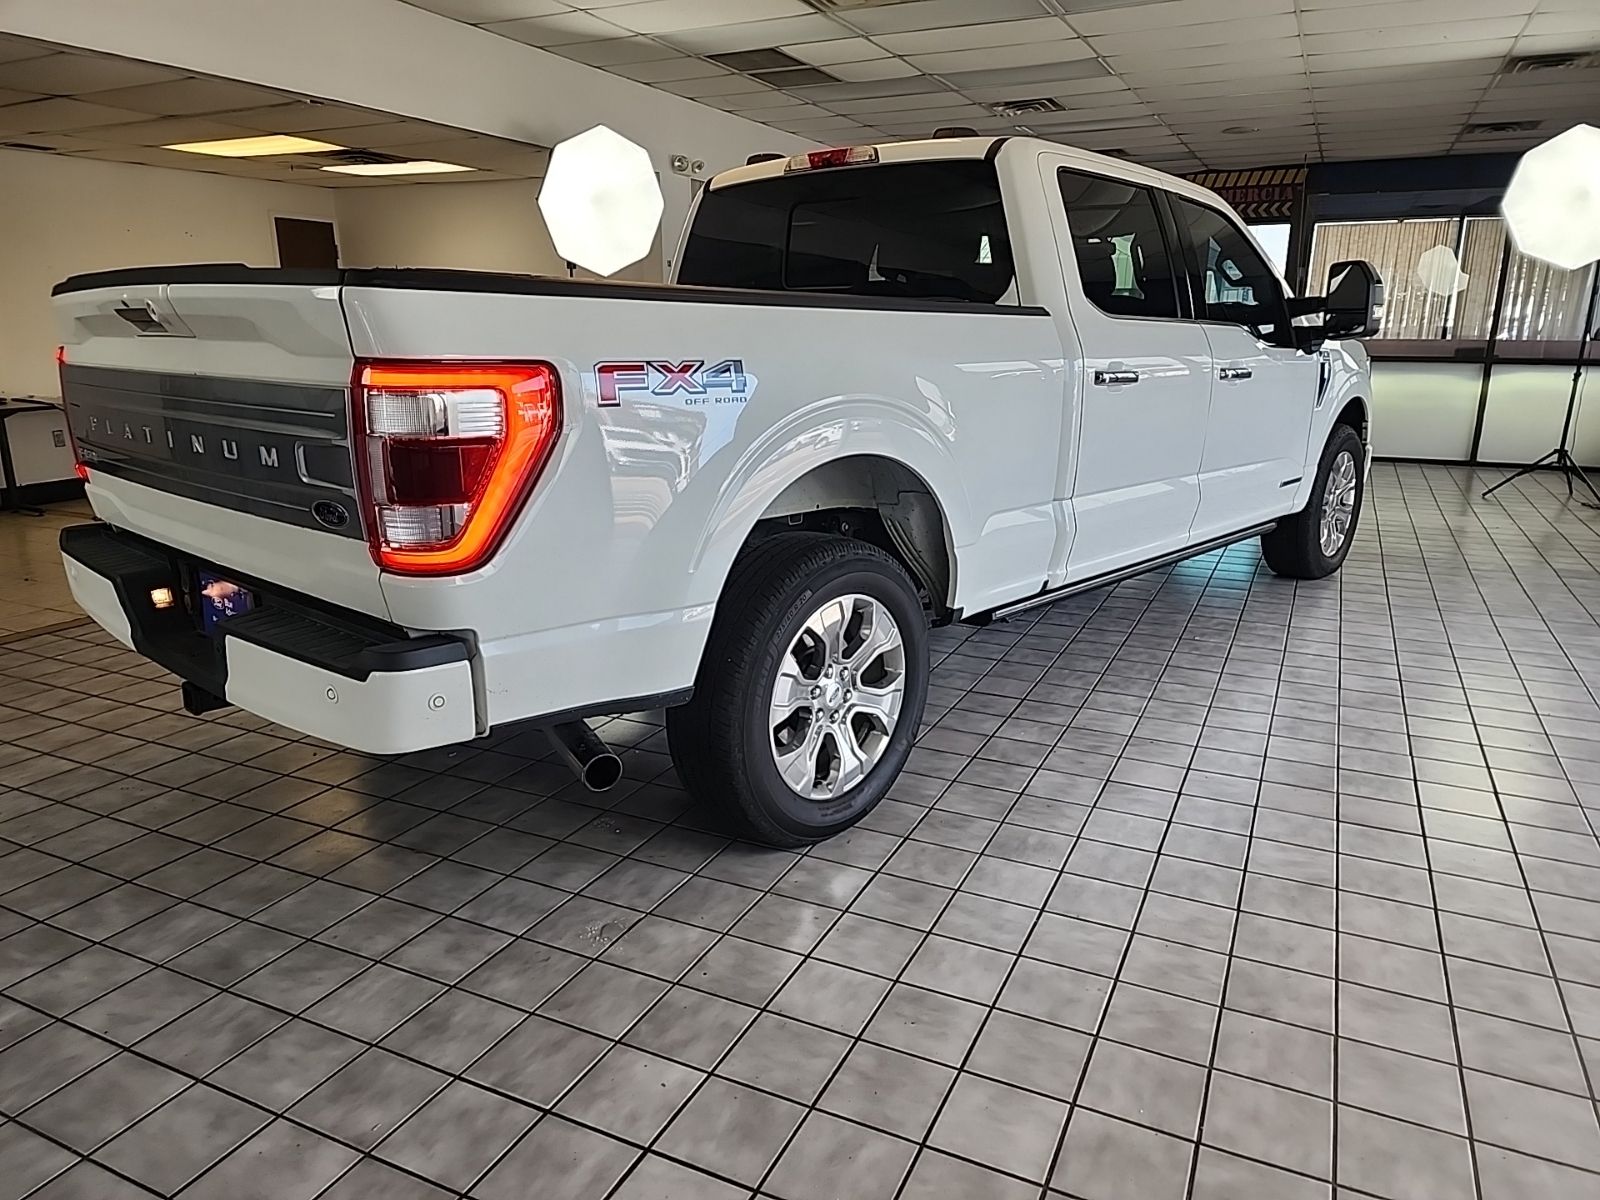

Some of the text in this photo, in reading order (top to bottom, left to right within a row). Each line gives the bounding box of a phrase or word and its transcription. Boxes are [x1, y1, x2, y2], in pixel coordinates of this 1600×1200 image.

[593, 359, 746, 407] FX4
[715, 396, 747, 404] ROAD
[89, 416, 279, 468] PLATINUM
